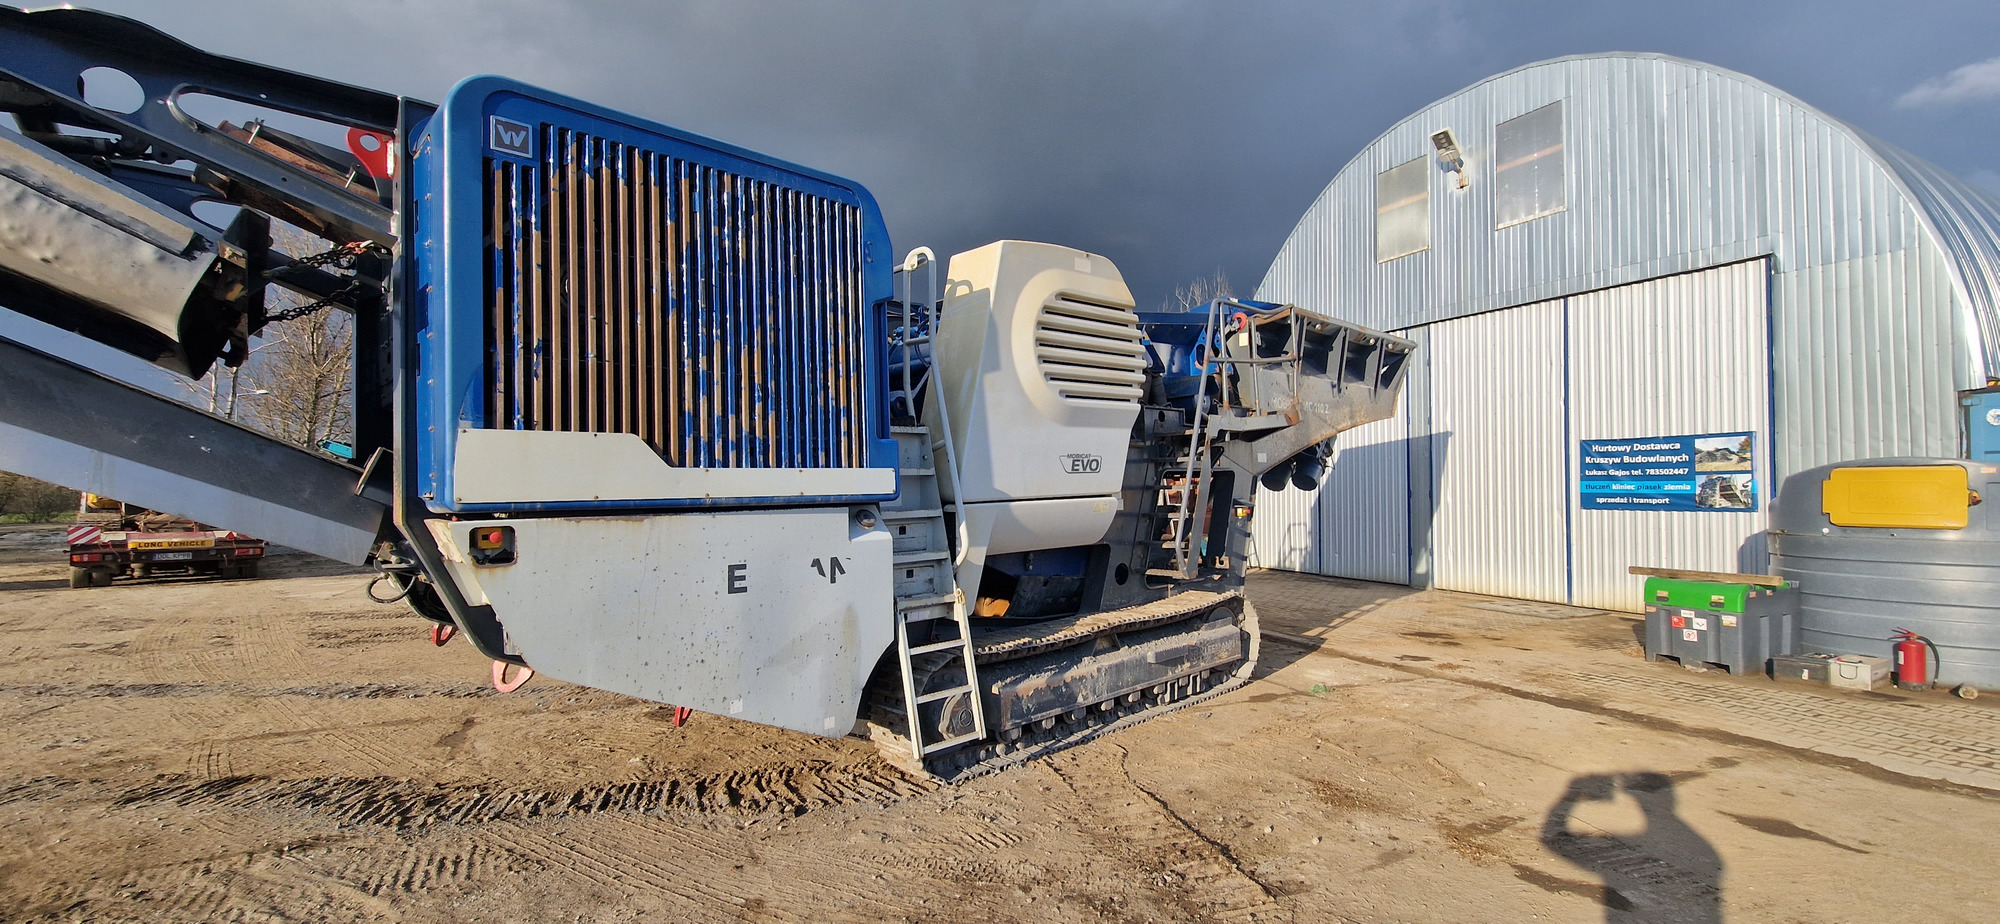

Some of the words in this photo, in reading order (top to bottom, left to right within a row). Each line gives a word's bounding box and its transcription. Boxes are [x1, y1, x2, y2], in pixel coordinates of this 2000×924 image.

[1592, 444, 1631, 453] Hurtowy
[1633, 442, 1681, 451] Dostawca
[1585, 456, 1621, 465] Kruszyw
[1623, 453, 1689, 464] Budowlanych
[1071, 459, 1100, 472] EVO
[1608, 469, 1630, 477] Gajos
[1637, 483, 1662, 491] piasek
[1633, 497, 1670, 505] transport
